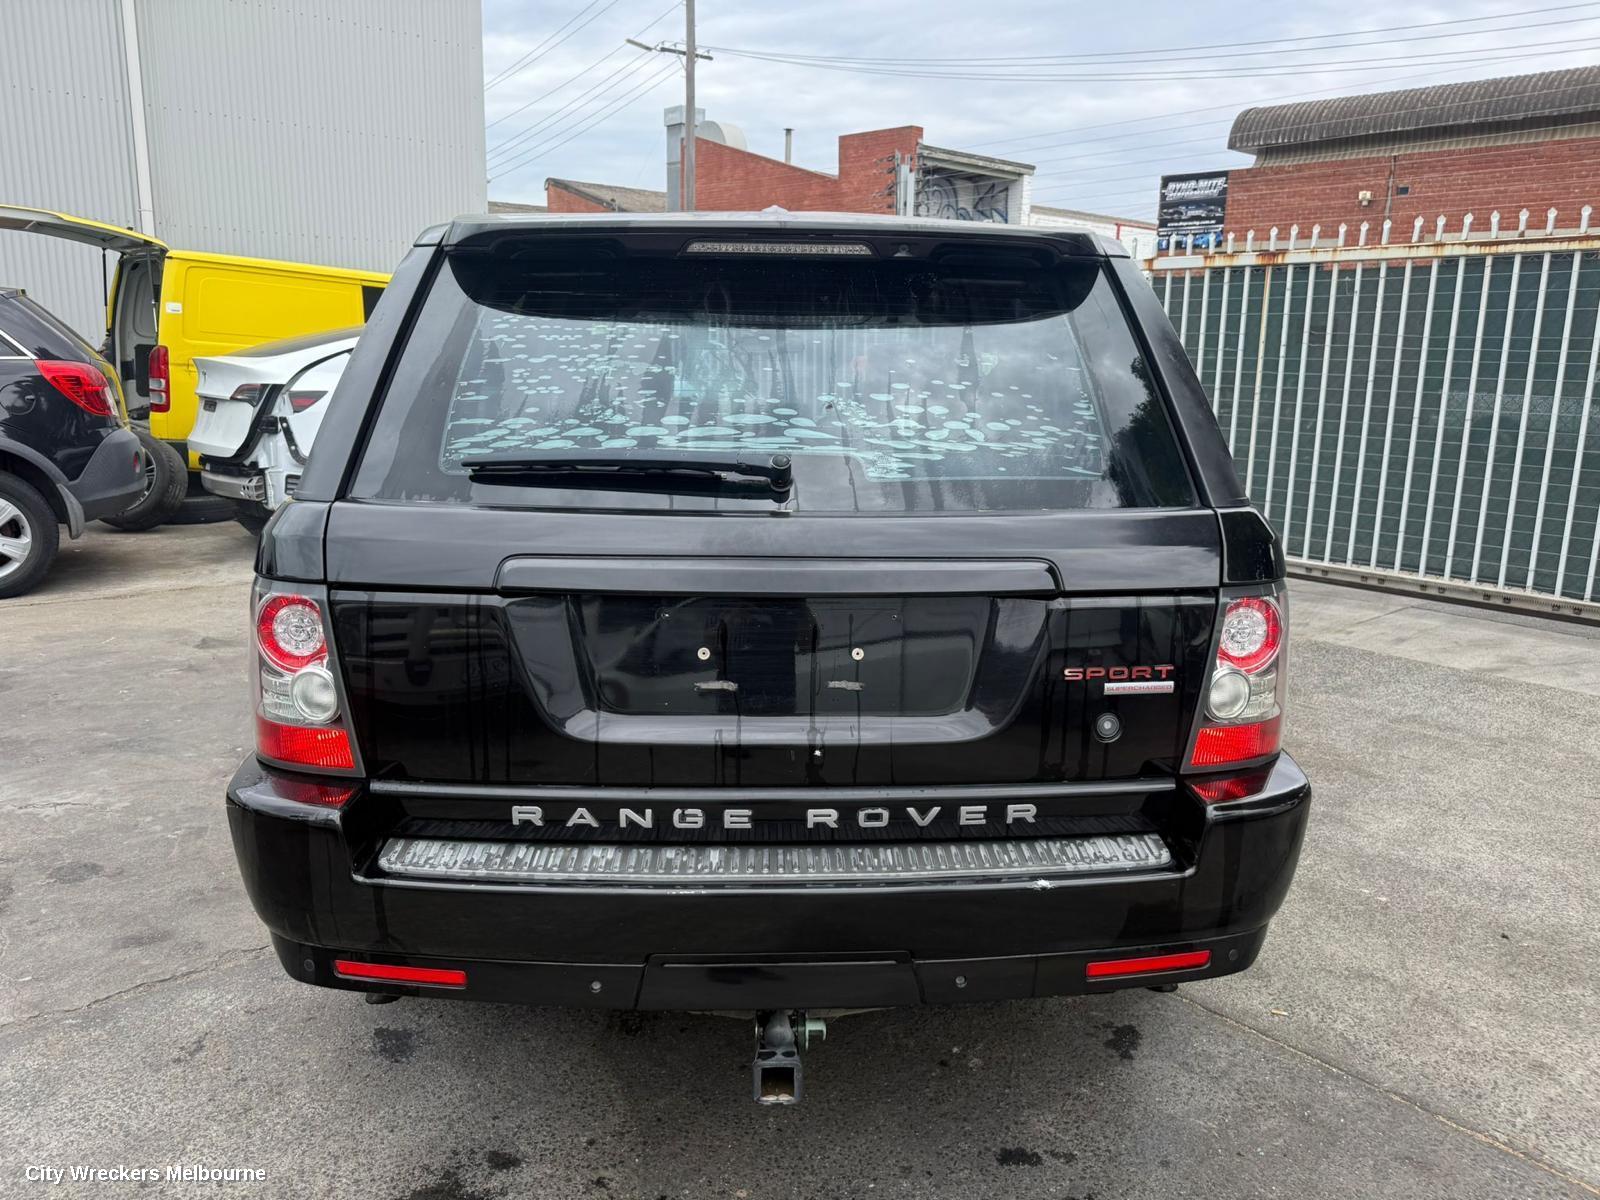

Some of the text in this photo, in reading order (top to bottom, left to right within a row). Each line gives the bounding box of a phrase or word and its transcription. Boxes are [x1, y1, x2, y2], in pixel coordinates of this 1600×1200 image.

[1064, 664, 1174, 680] SPORT
[511, 804, 1037, 829] RANGE ROVER
